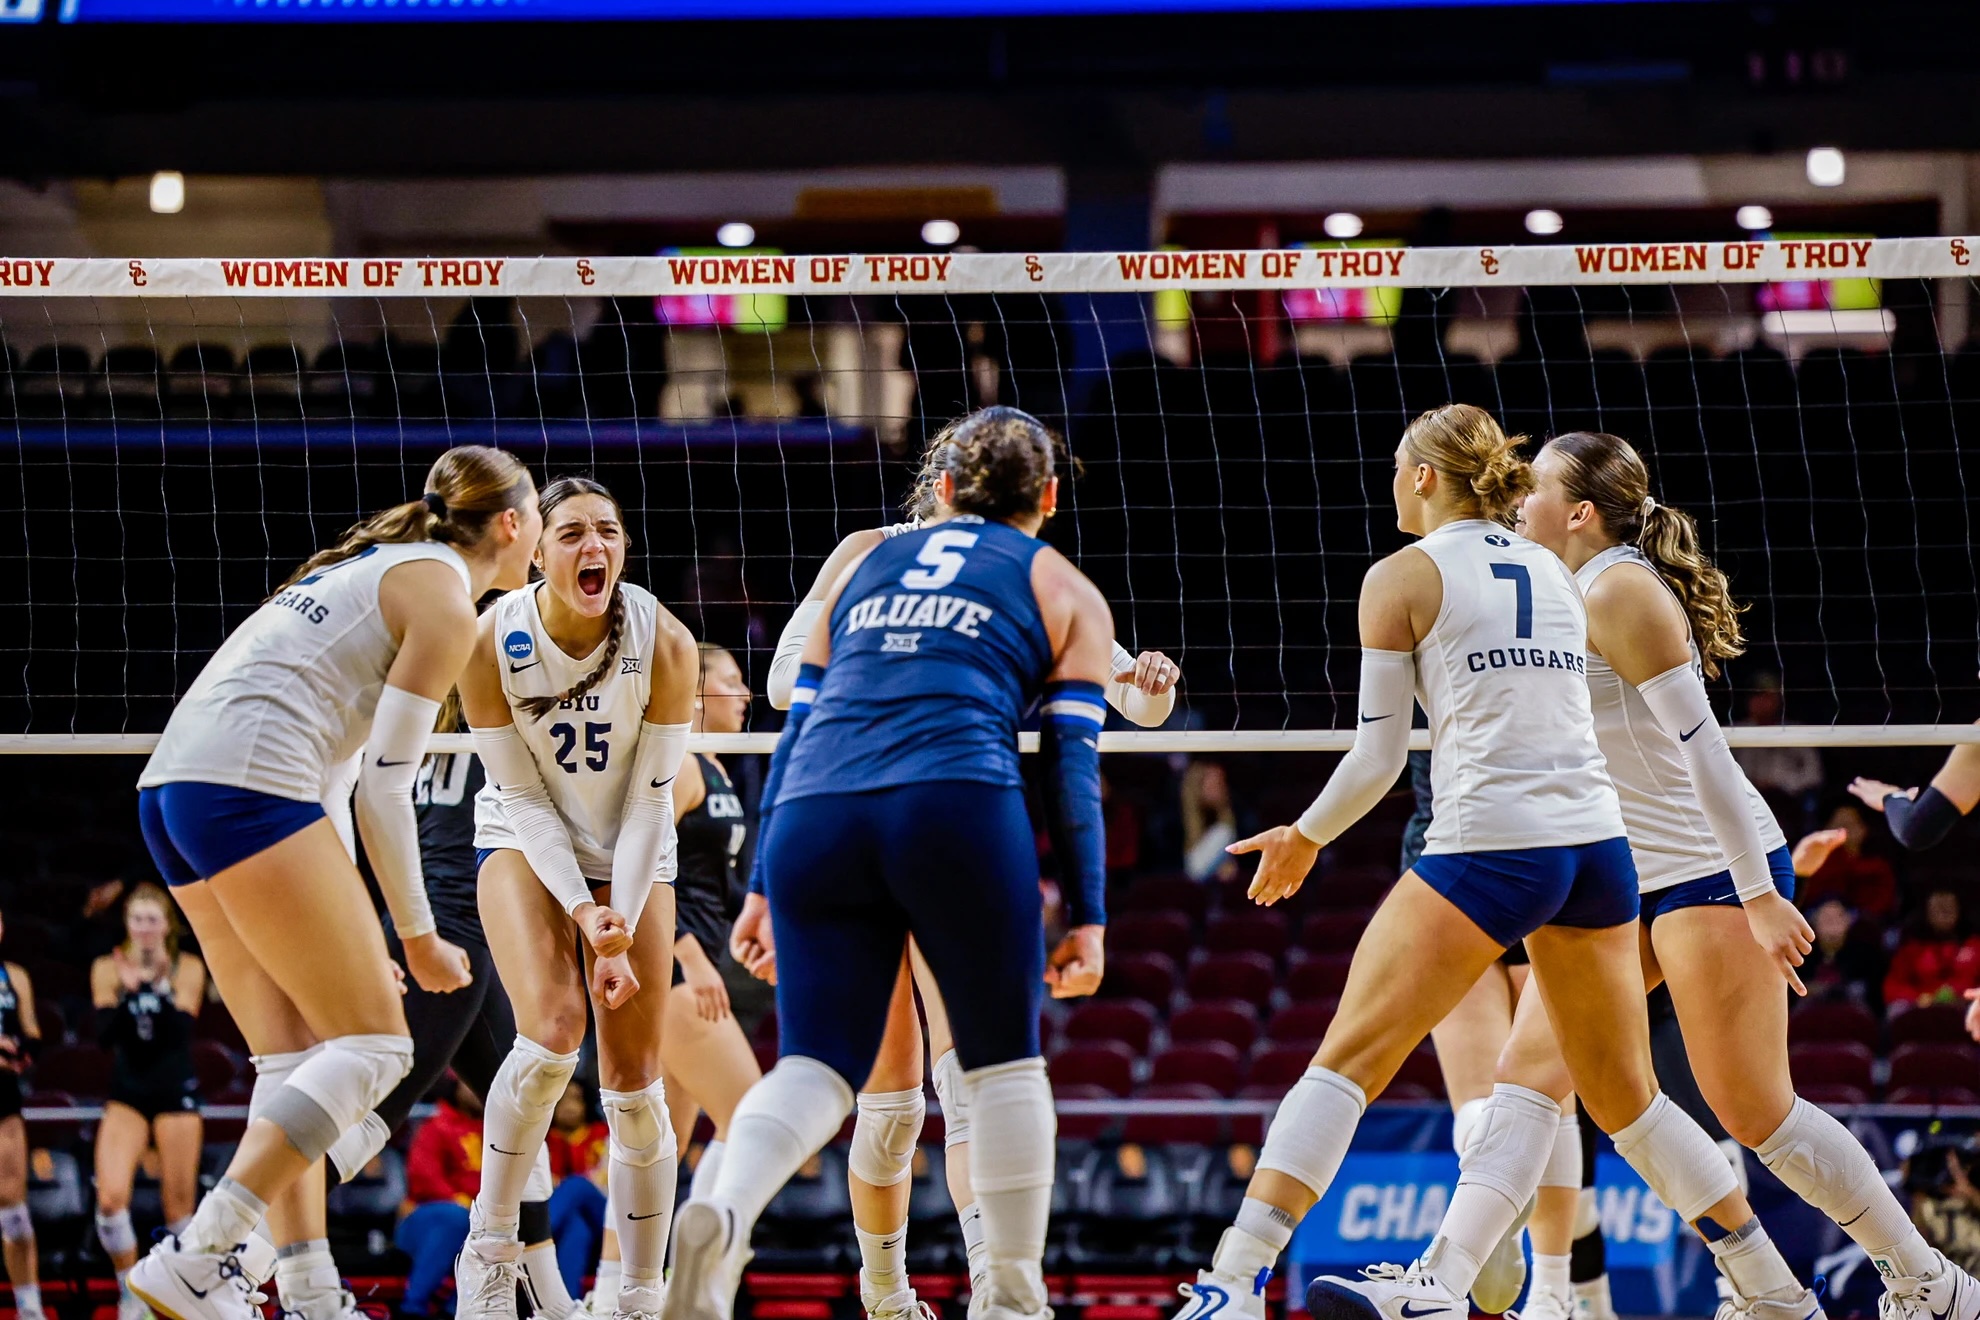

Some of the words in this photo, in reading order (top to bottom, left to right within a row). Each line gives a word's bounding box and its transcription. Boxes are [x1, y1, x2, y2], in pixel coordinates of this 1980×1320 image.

[669, 258, 796, 285] WOMEN
[811, 257, 850, 283] OF
[865, 256, 952, 282] TROY
[1119, 252, 1247, 280] WOMEN
[1260, 251, 1302, 278] OF
[1318, 250, 1406, 277] TROY
[1576, 245, 1707, 272] WOMEN
[1723, 243, 1764, 270] OF
[1781, 241, 1872, 269] TROY
[221, 261, 349, 287] WOMEN
[363, 261, 402, 287] OF
[418, 259, 503, 286] TROY
[901, 529, 979, 590] 5
[1489, 563, 1533, 639] 7
[508, 643, 531, 653] NCAA
[1467, 648, 1585, 675] COUGARS
[549, 721, 612, 774] 25
